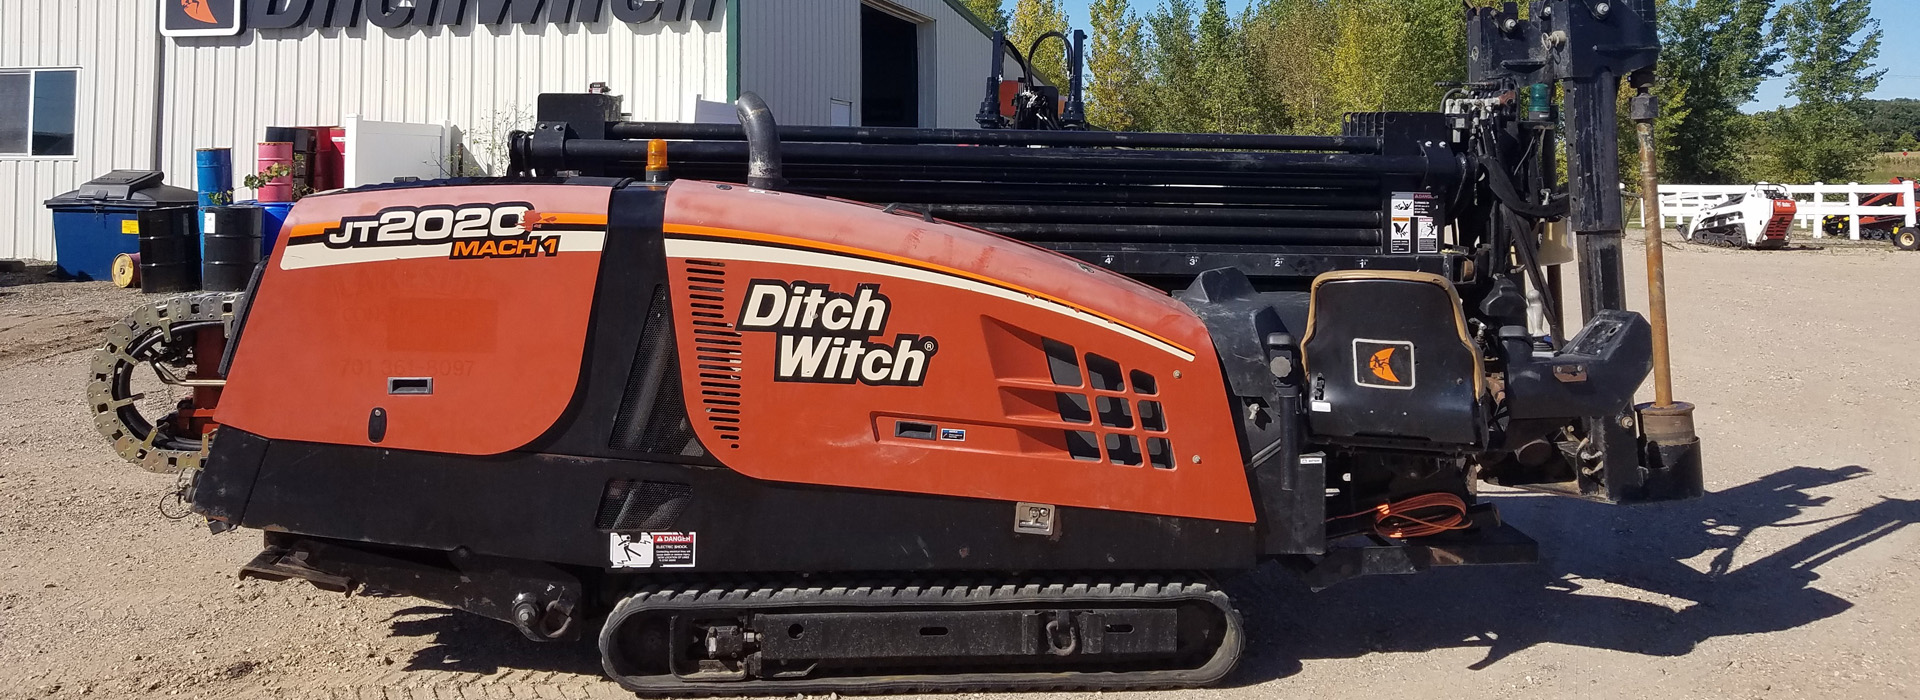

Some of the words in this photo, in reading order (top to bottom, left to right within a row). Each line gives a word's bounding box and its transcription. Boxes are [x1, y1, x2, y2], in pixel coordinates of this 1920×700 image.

[329, 205, 526, 243] JT2020
[453, 239, 538, 256] MACH
[543, 238, 557, 254] 1
[742, 284, 886, 331] Ditch
